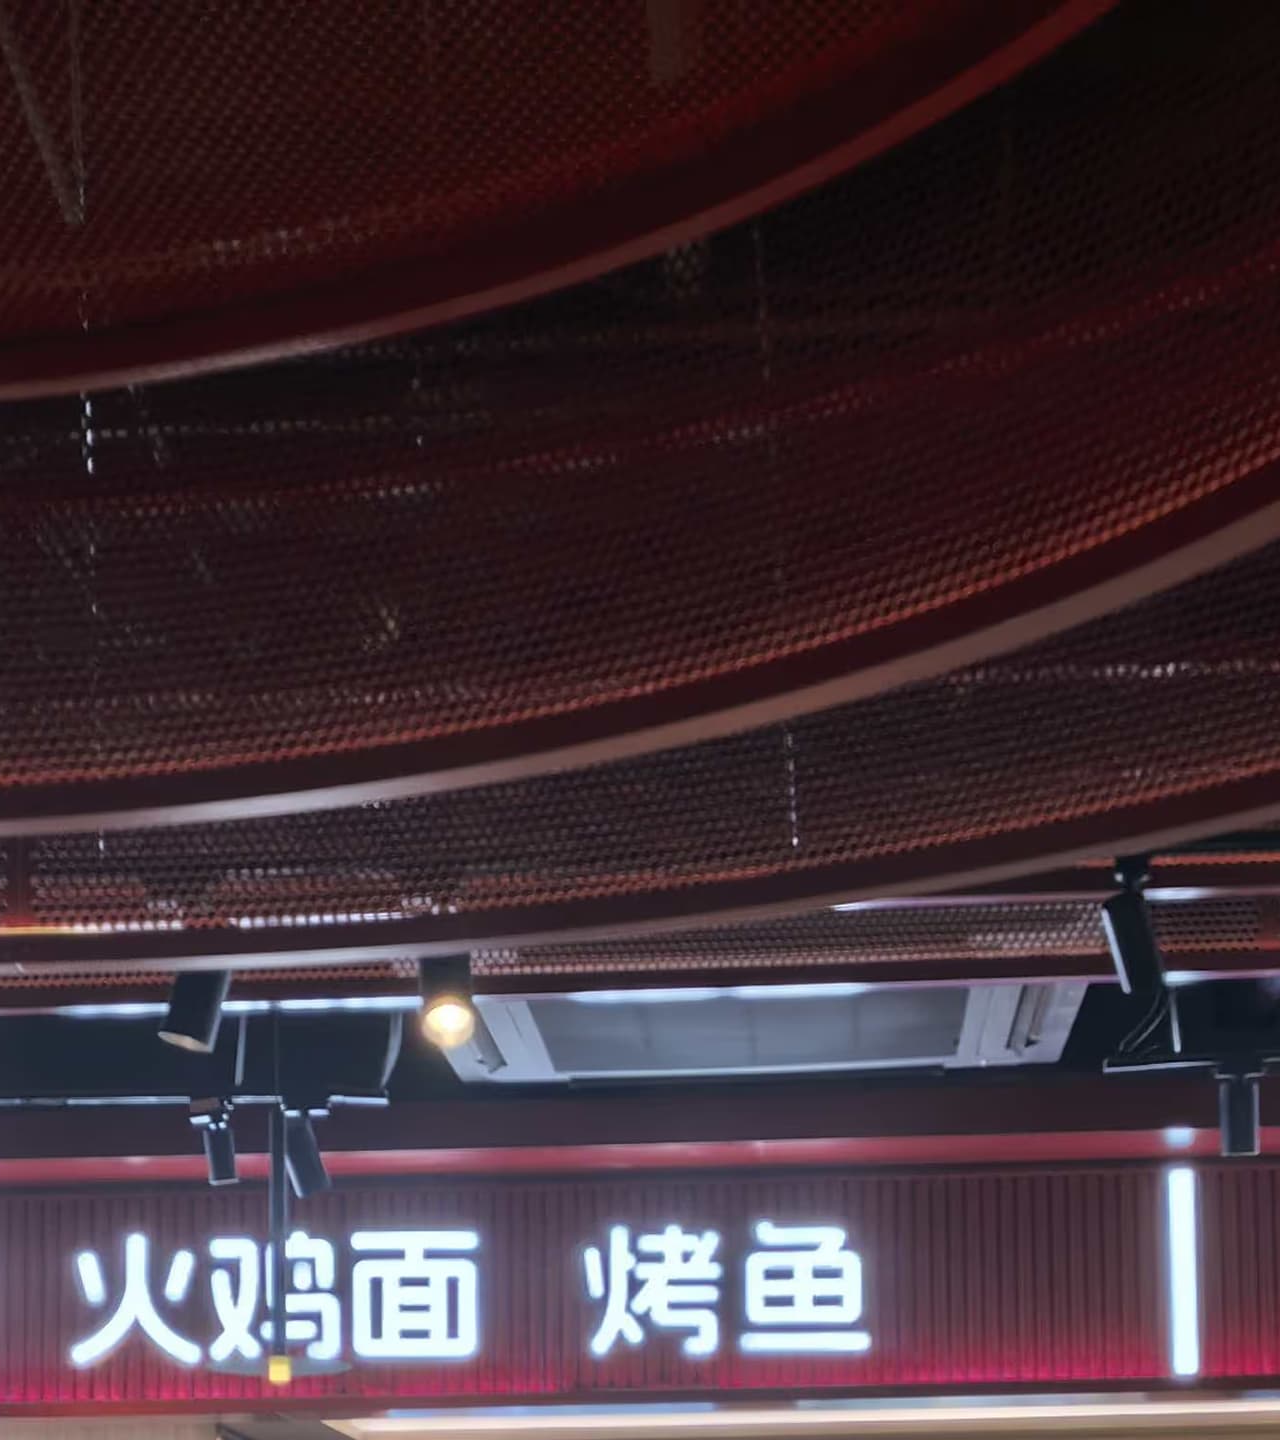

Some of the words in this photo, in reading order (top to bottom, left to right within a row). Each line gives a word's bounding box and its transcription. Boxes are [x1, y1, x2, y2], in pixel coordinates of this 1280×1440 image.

[70, 1230, 479, 1365] 火鸡面
[583, 1221, 872, 1355] 烤鱼
